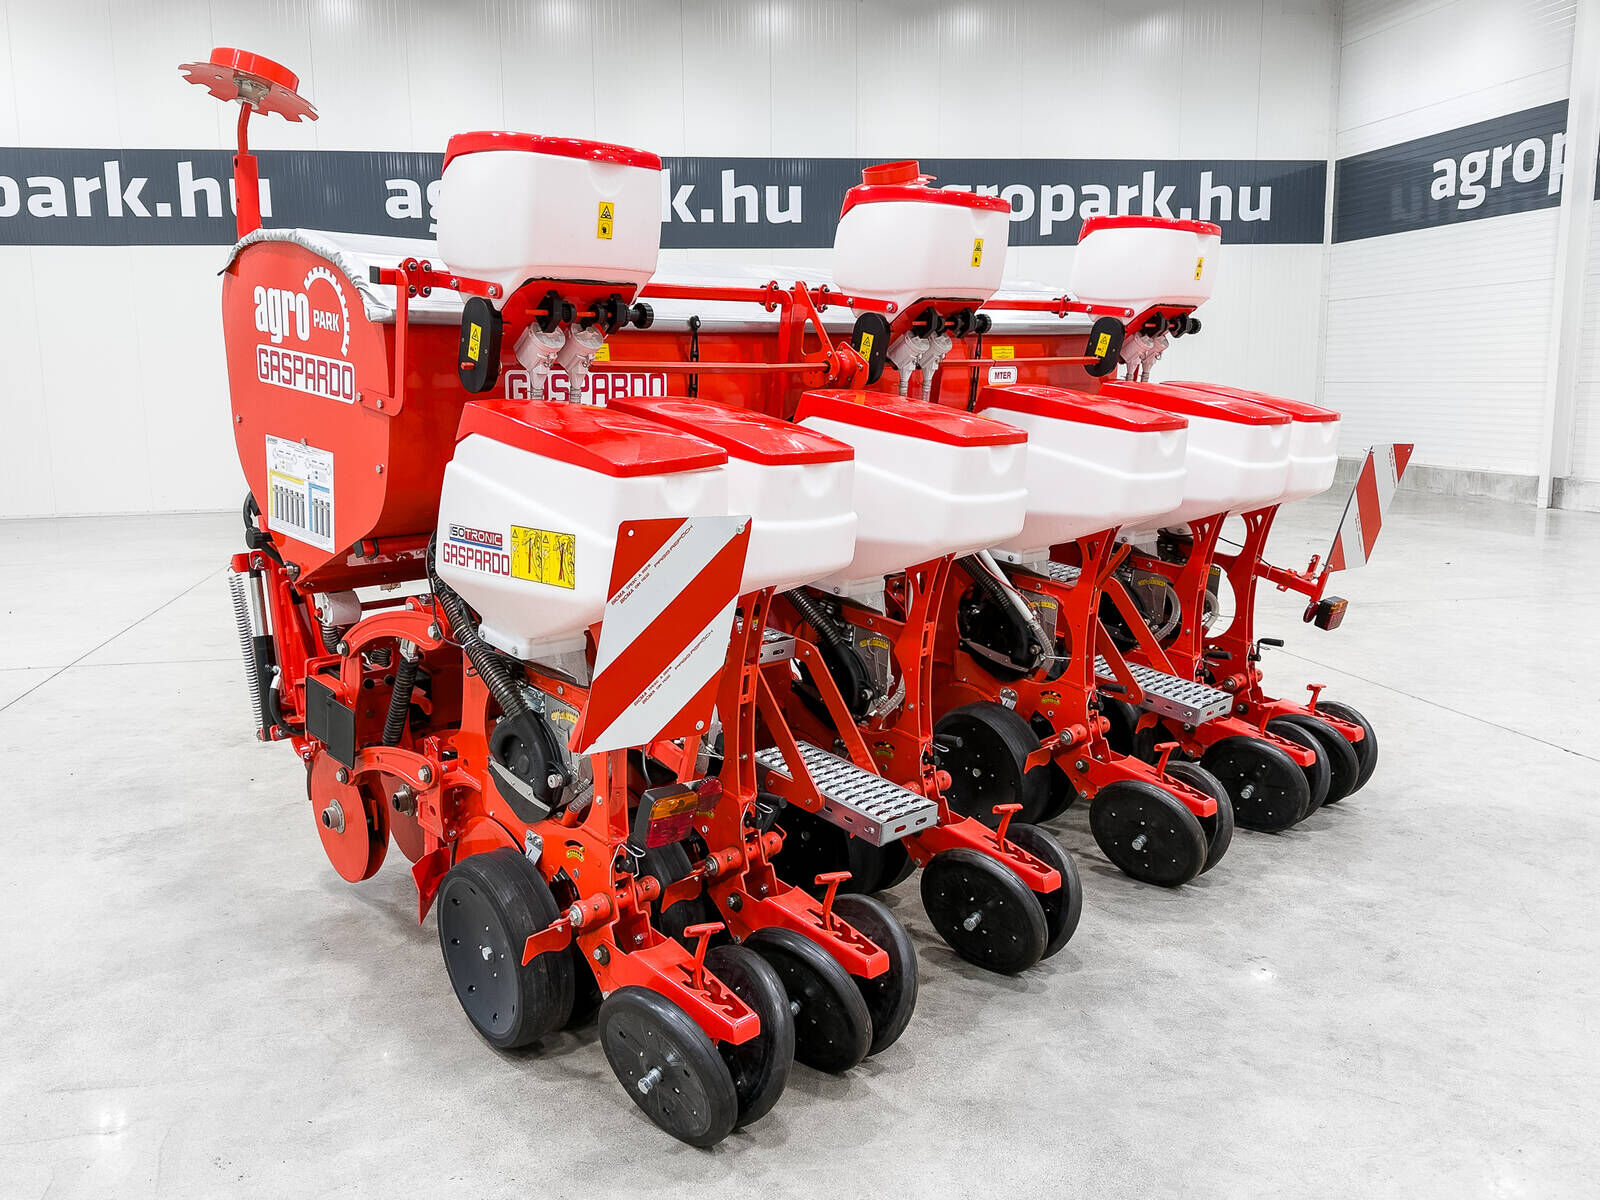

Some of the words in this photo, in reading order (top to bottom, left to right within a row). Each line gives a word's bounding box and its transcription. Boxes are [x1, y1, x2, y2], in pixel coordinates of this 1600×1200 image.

[254, 286, 310, 343] agro
[313, 309, 340, 332] PARK
[258, 348, 353, 400] GASPARDO
[443, 543, 510, 576] GASPARDO
